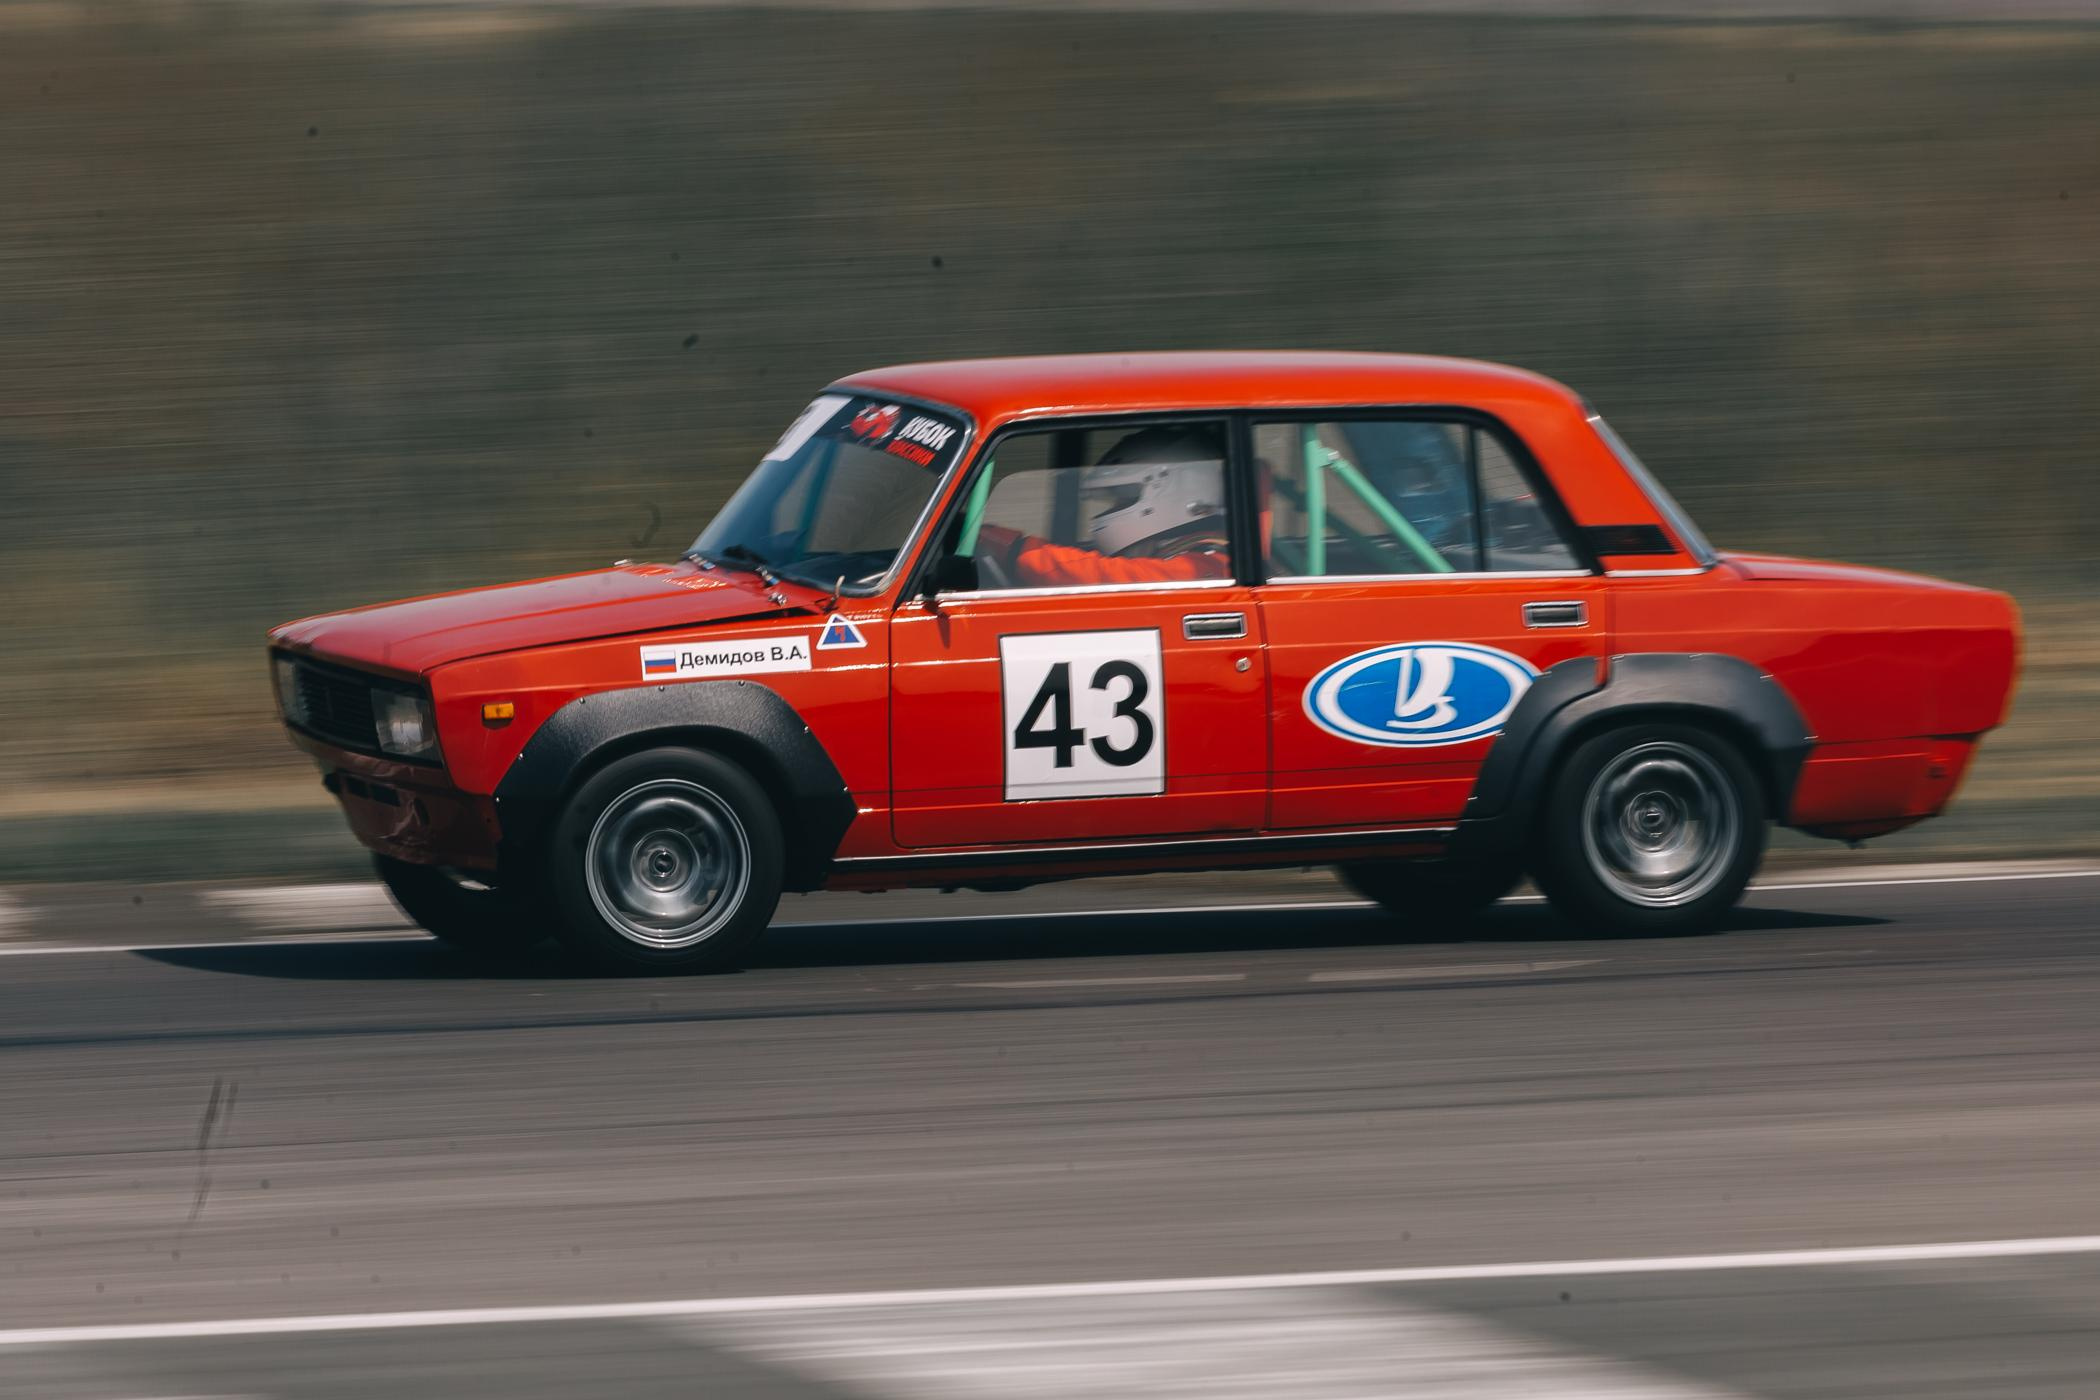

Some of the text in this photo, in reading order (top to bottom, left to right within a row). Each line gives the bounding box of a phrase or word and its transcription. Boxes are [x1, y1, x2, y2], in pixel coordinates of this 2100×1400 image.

[894, 416, 957, 451] КУБОК
[680, 645, 807, 669] Демидов В.А.
[1014, 660, 1155, 768] 43
